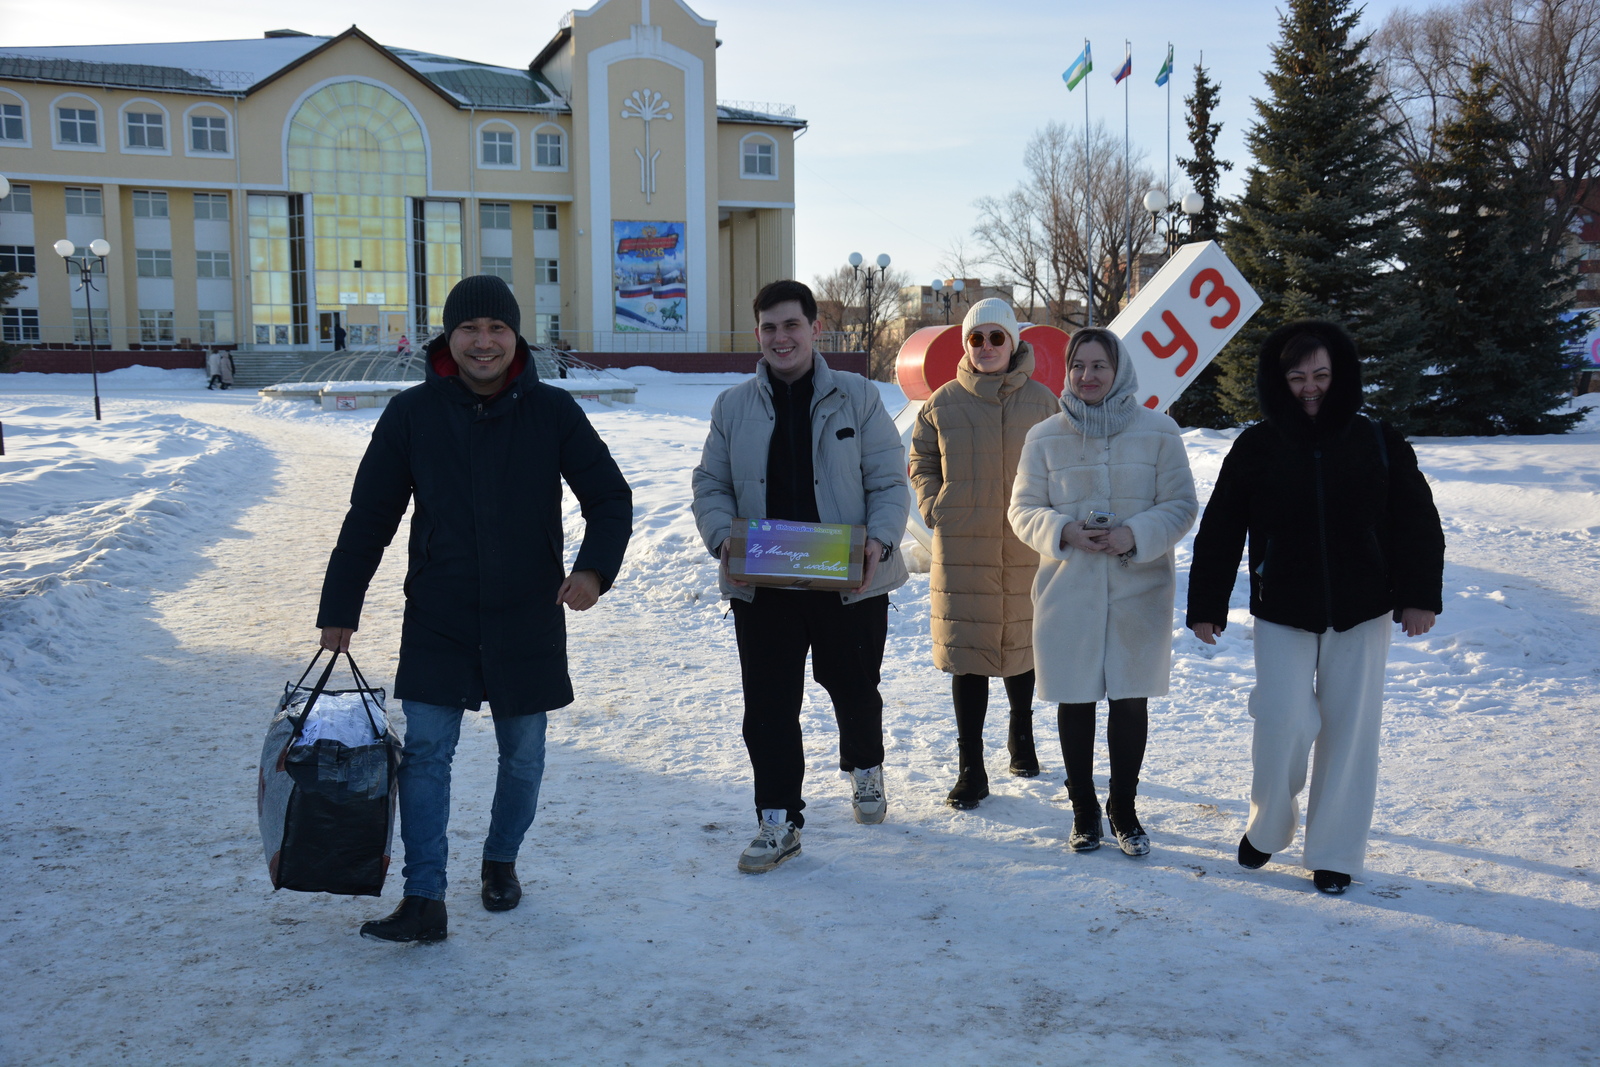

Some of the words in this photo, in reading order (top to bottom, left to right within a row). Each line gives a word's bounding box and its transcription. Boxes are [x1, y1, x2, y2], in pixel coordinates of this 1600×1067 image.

[636, 247, 664, 257] 2026
[749, 544, 763, 558] Из
[766, 545, 809, 561] Мелеуза
[804, 561, 847, 571] любовью
